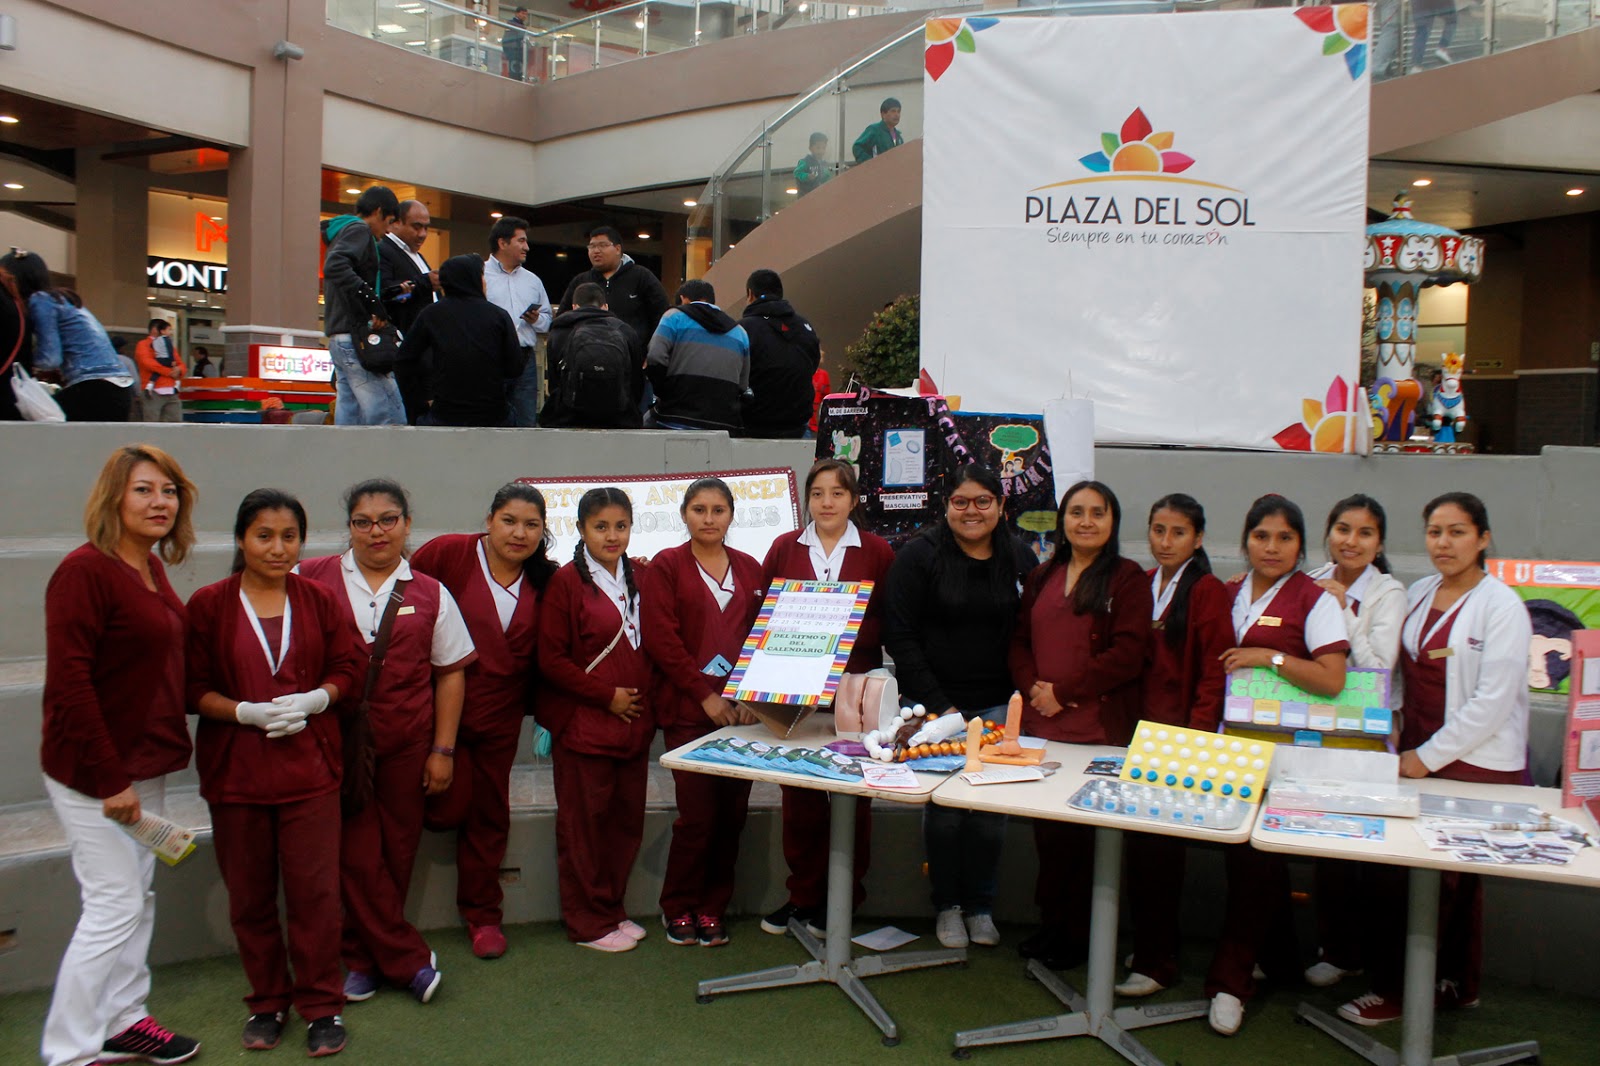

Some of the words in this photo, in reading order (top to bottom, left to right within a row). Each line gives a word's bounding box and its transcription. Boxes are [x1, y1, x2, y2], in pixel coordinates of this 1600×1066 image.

[1025, 196, 1122, 224] PLAZA
[1134, 197, 1186, 225] DEL
[1195, 197, 1256, 226] SOL
[1046, 226, 1111, 249] Siempre
[1115, 231, 1134, 244] en
[1141, 231, 1157, 244] tu
[146, 260, 229, 291] MONT
[315, 360, 335, 372] PET
[645, 477, 788, 505] ANTNCEP
